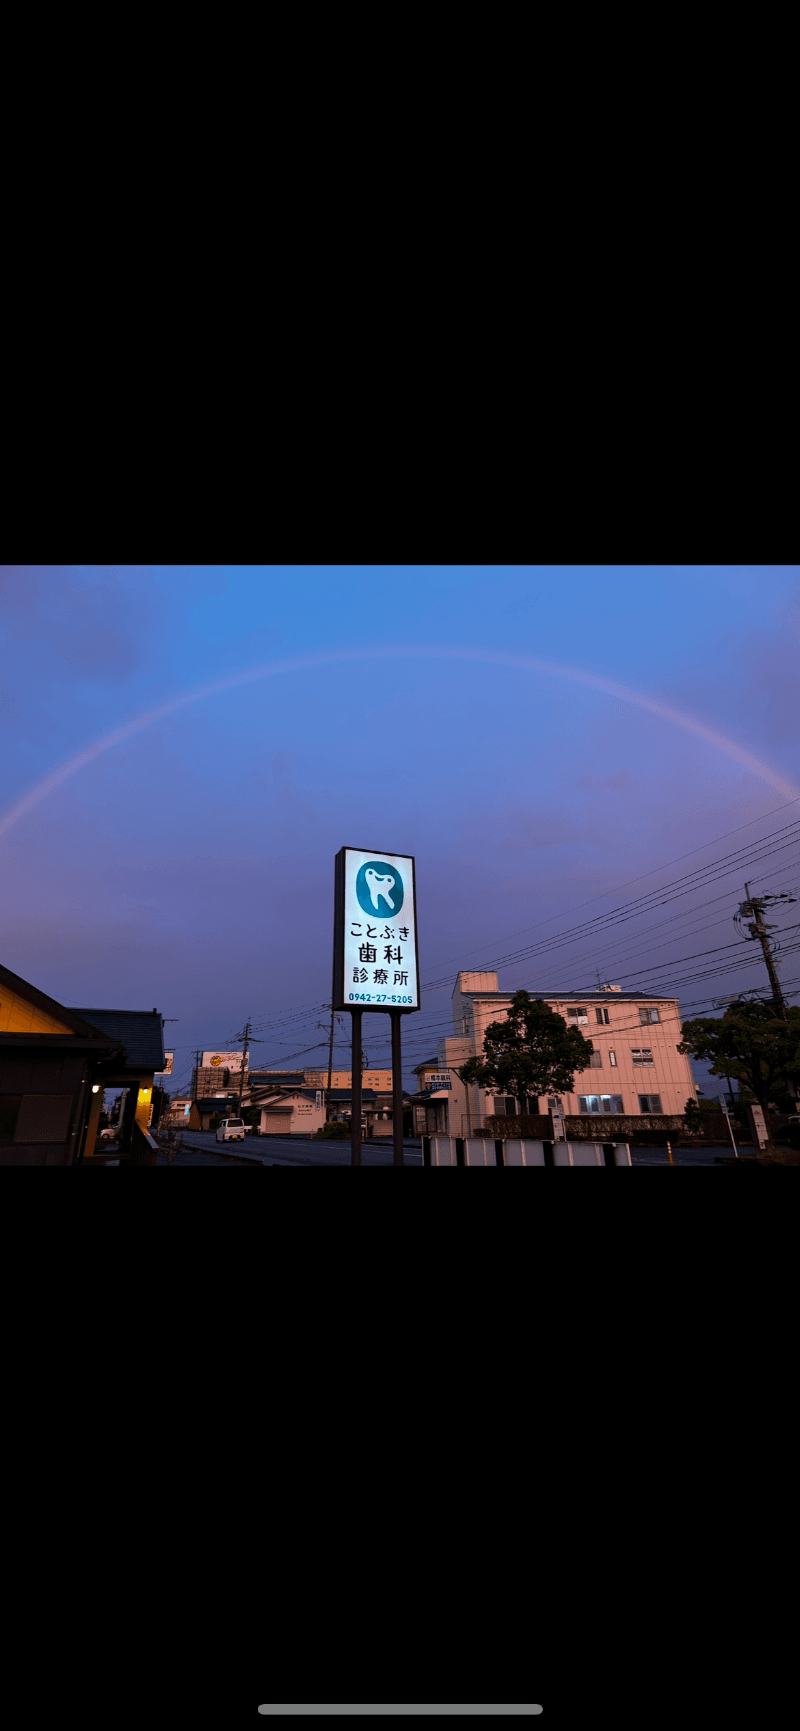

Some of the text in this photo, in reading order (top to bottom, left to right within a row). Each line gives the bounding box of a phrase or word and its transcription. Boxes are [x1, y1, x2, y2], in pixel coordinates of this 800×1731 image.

[351, 922, 410, 941] ことぶき
[358, 942, 403, 965] 歯科
[352, 967, 409, 986] 診療所
[348, 993, 413, 1004] 0942-27-5205
